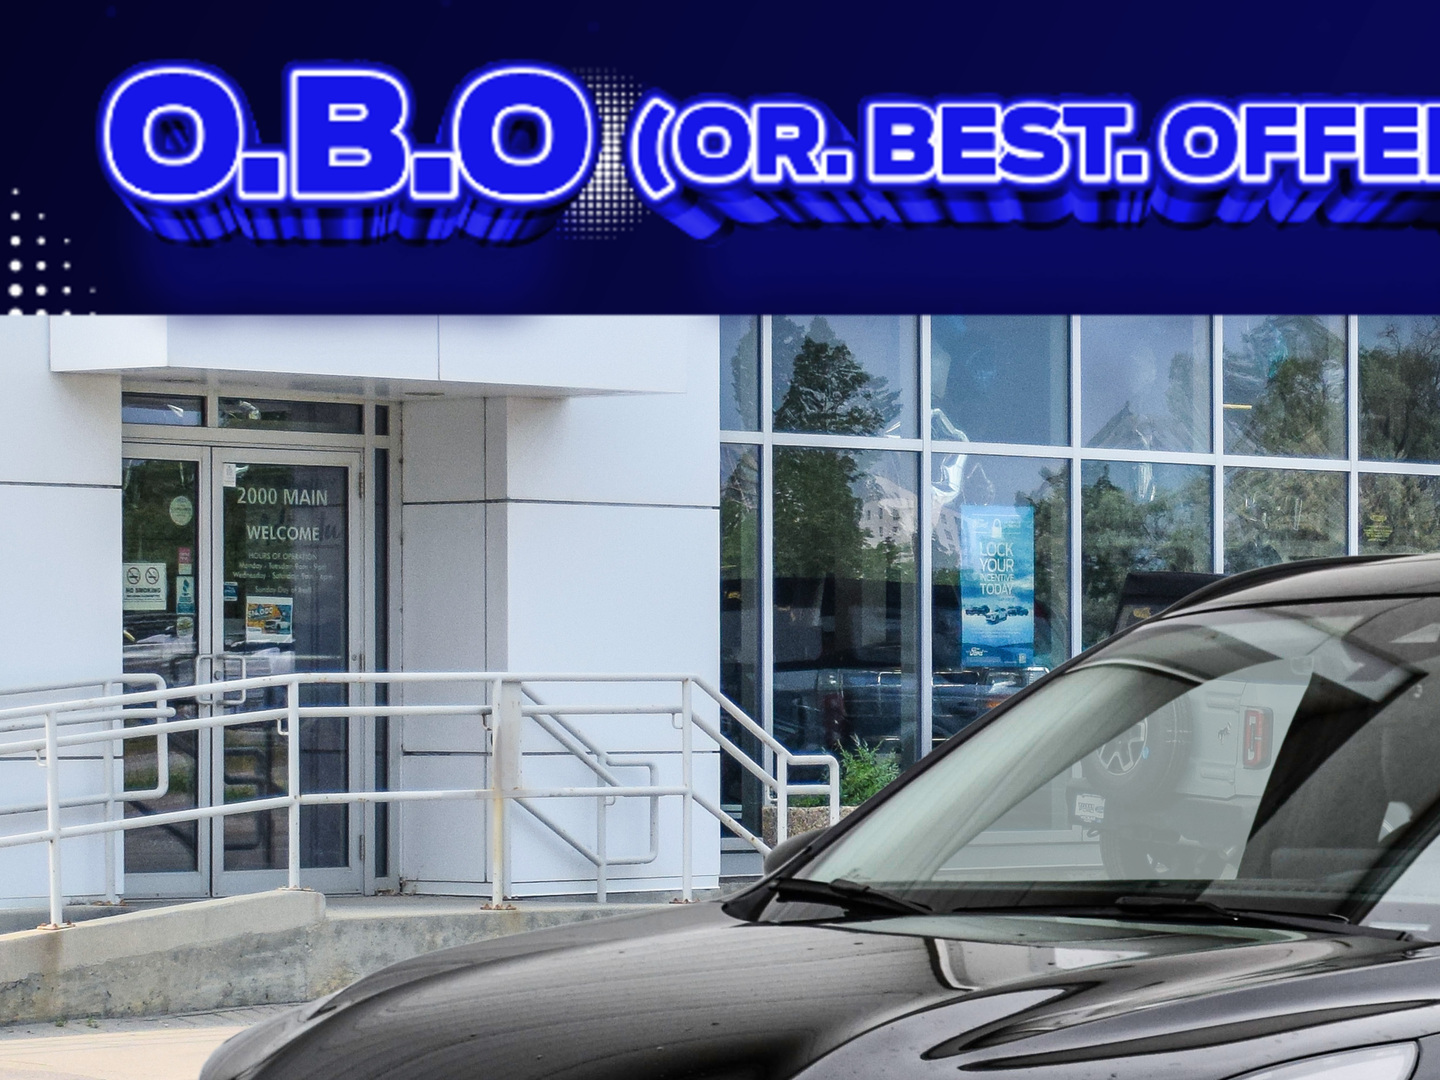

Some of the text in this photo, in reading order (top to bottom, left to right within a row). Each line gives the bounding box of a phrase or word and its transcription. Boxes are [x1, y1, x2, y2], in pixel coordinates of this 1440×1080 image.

[236, 487, 328, 506] 2000 MAIN
[246, 525, 320, 541] WELCOME
[979, 541, 1014, 557] LOCK
[979, 558, 1015, 573] YOUR
[980, 583, 1014, 595] TODAY
